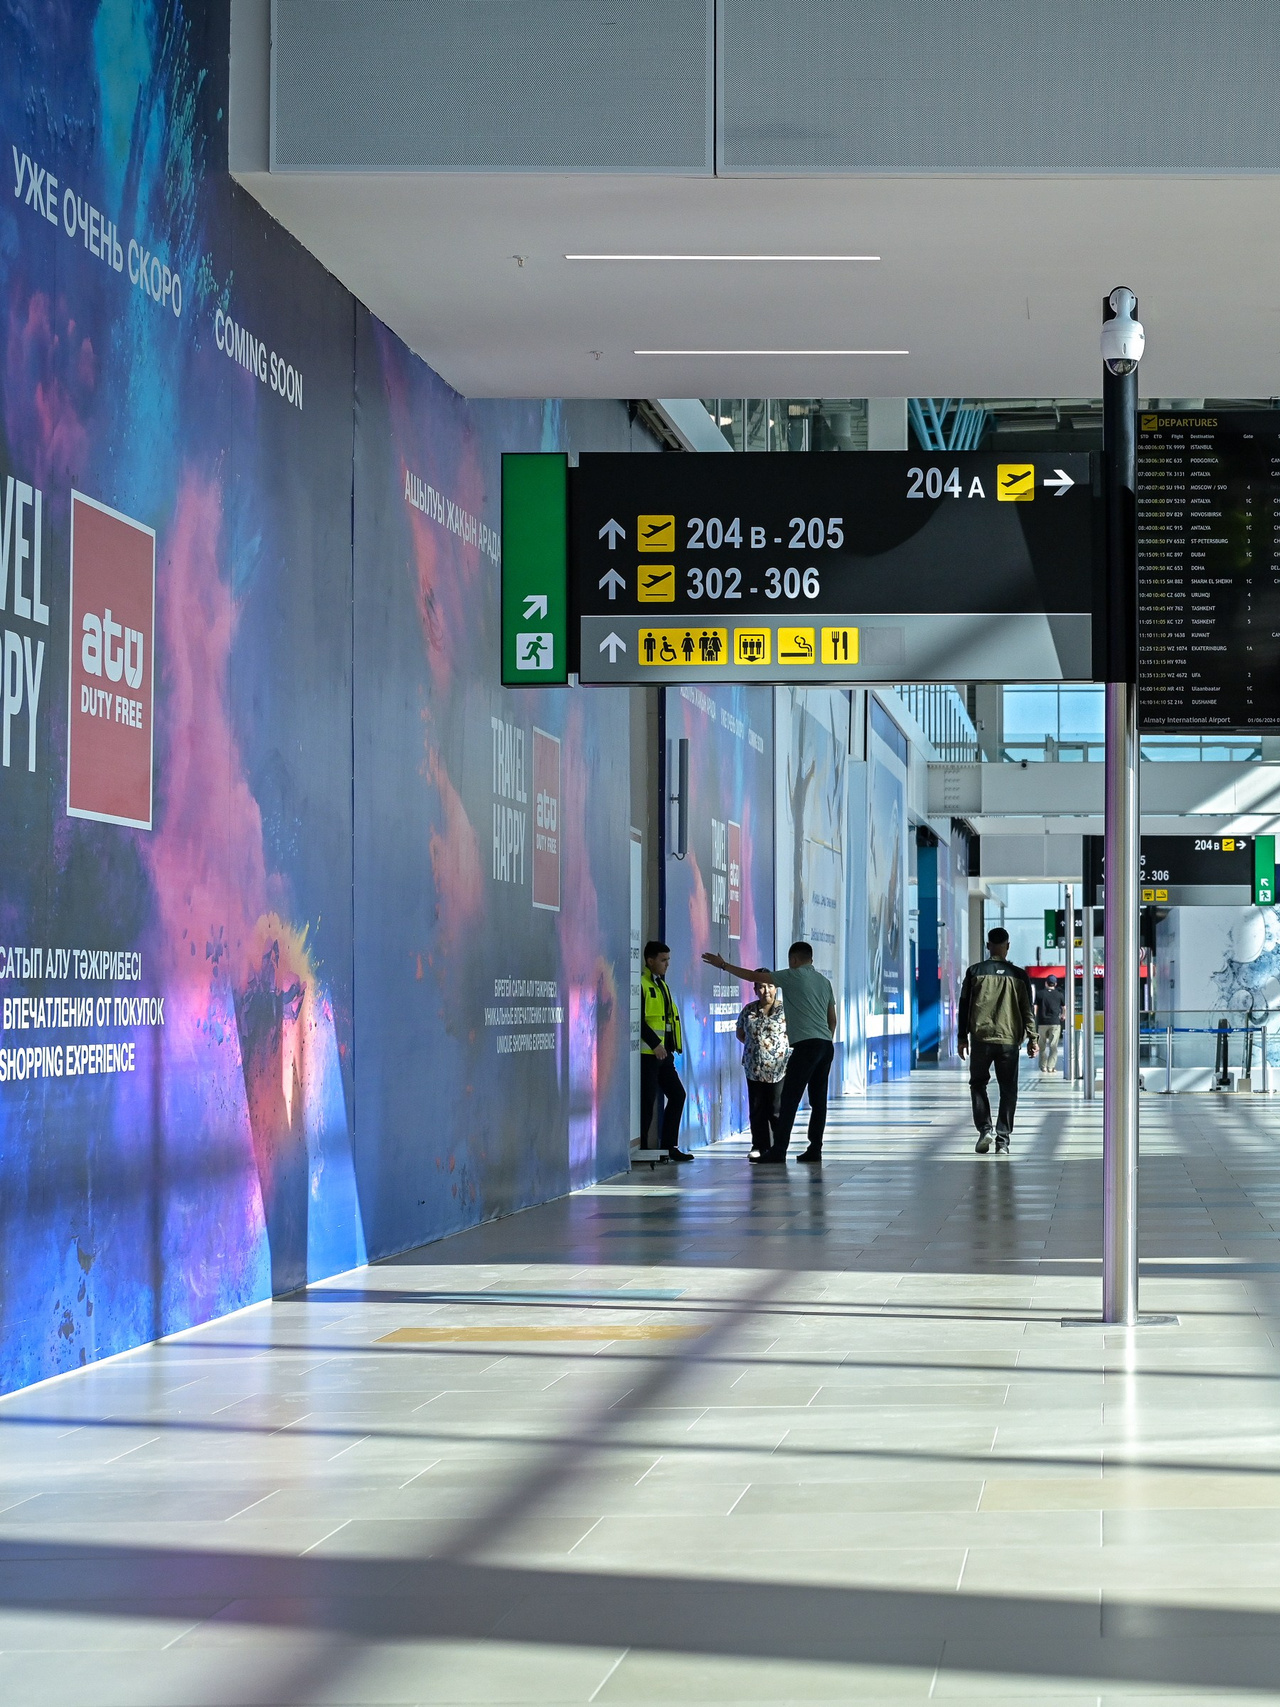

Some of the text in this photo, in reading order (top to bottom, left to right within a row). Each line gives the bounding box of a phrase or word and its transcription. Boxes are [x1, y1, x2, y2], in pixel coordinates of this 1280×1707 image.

[12, 144, 182, 317] УЖЕ ОЧЕНЬ СКОРО
[215, 308, 302, 410] COMING SOON
[1158, 418, 1218, 427] DEPARTURES
[906, 467, 986, 499] 204 A
[405, 470, 445, 526] АШЫЛУЫ
[446, 498, 477, 546] ЖАҚЫН
[687, 518, 743, 549] 204
[751, 526, 766, 549] B
[788, 518, 844, 549] 205
[687, 568, 742, 599] 302
[764, 568, 820, 599] 306
[81, 684, 143, 729] DUTY FREE
[1143, 717, 1166, 725] Almaty
[1208, 717, 1231, 725] Airport
[491, 716, 527, 804] TRAVEL
[493, 803, 526, 885] HAPPY
[1194, 840, 1212, 850] 204
[1151, 870, 1169, 881] 306
[0, 946, 141, 981] САТЫП АЛУ ТӘЖІРИБЕСІ
[3, 996, 165, 1030] ВПЕЧАТЛЕНИЯ ОТ ПОКУПОК
[0, 1043, 135, 1081] SHOPPING EXPERIENCE
